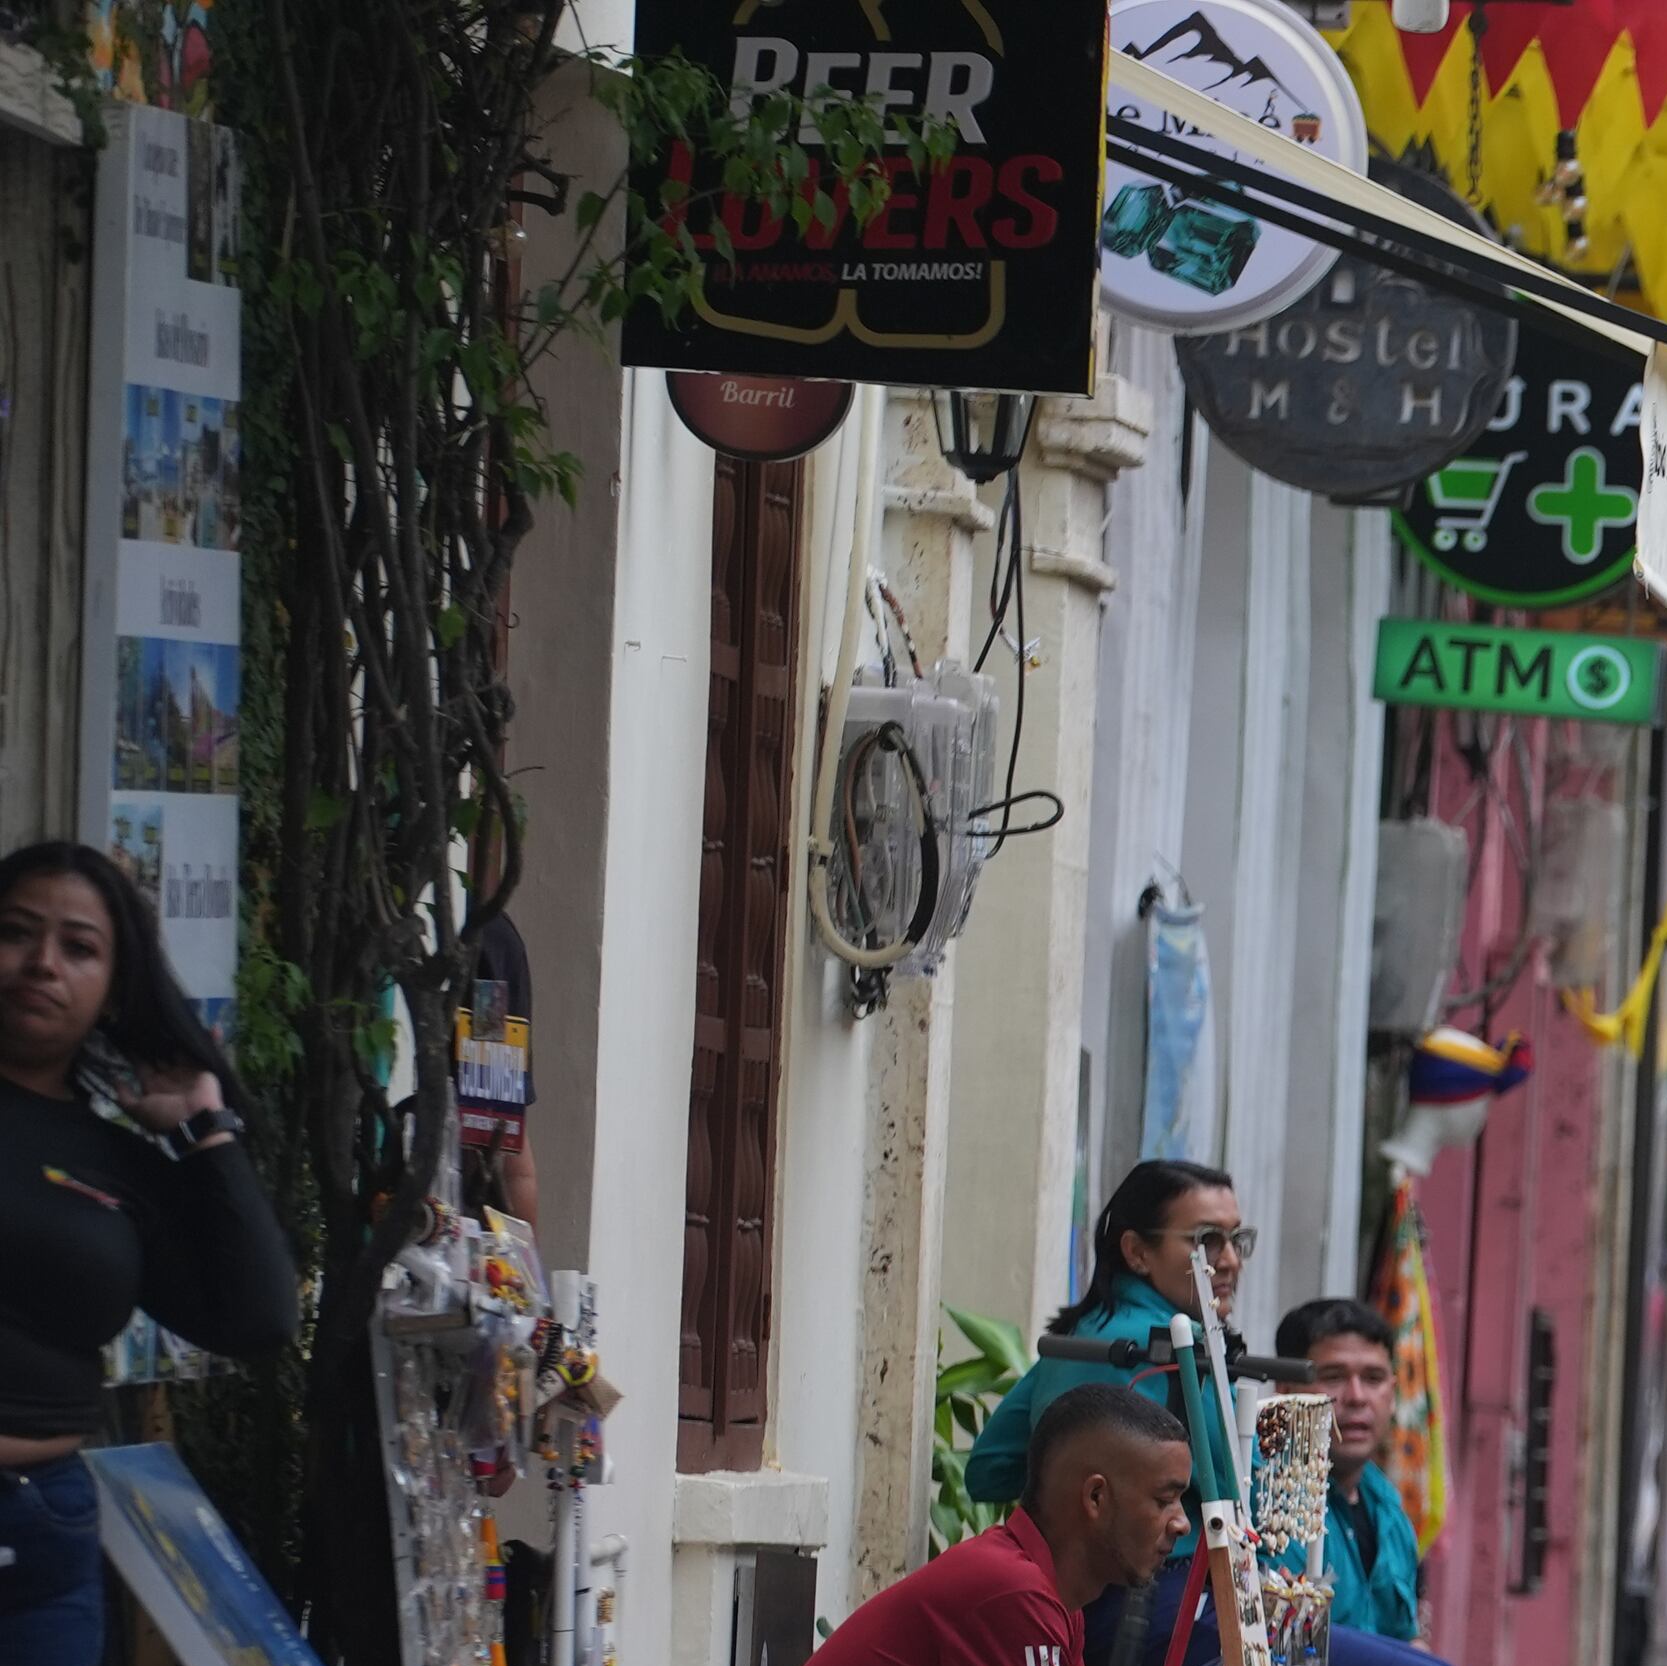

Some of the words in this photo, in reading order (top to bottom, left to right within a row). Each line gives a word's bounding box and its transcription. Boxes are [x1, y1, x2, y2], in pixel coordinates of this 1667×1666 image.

[729, 36, 994, 146] BEER
[664, 142, 1064, 251] LOVERS
[842, 262, 867, 281] LA
[873, 261, 984, 281] TOMAMOS!
[1224, 317, 1464, 371] Hostel
[719, 380, 797, 409] Barril
[1248, 380, 1291, 421] M
[1327, 381, 1360, 426] &
[1398, 383, 1443, 426] H
[1399, 634, 1551, 700] ATM
